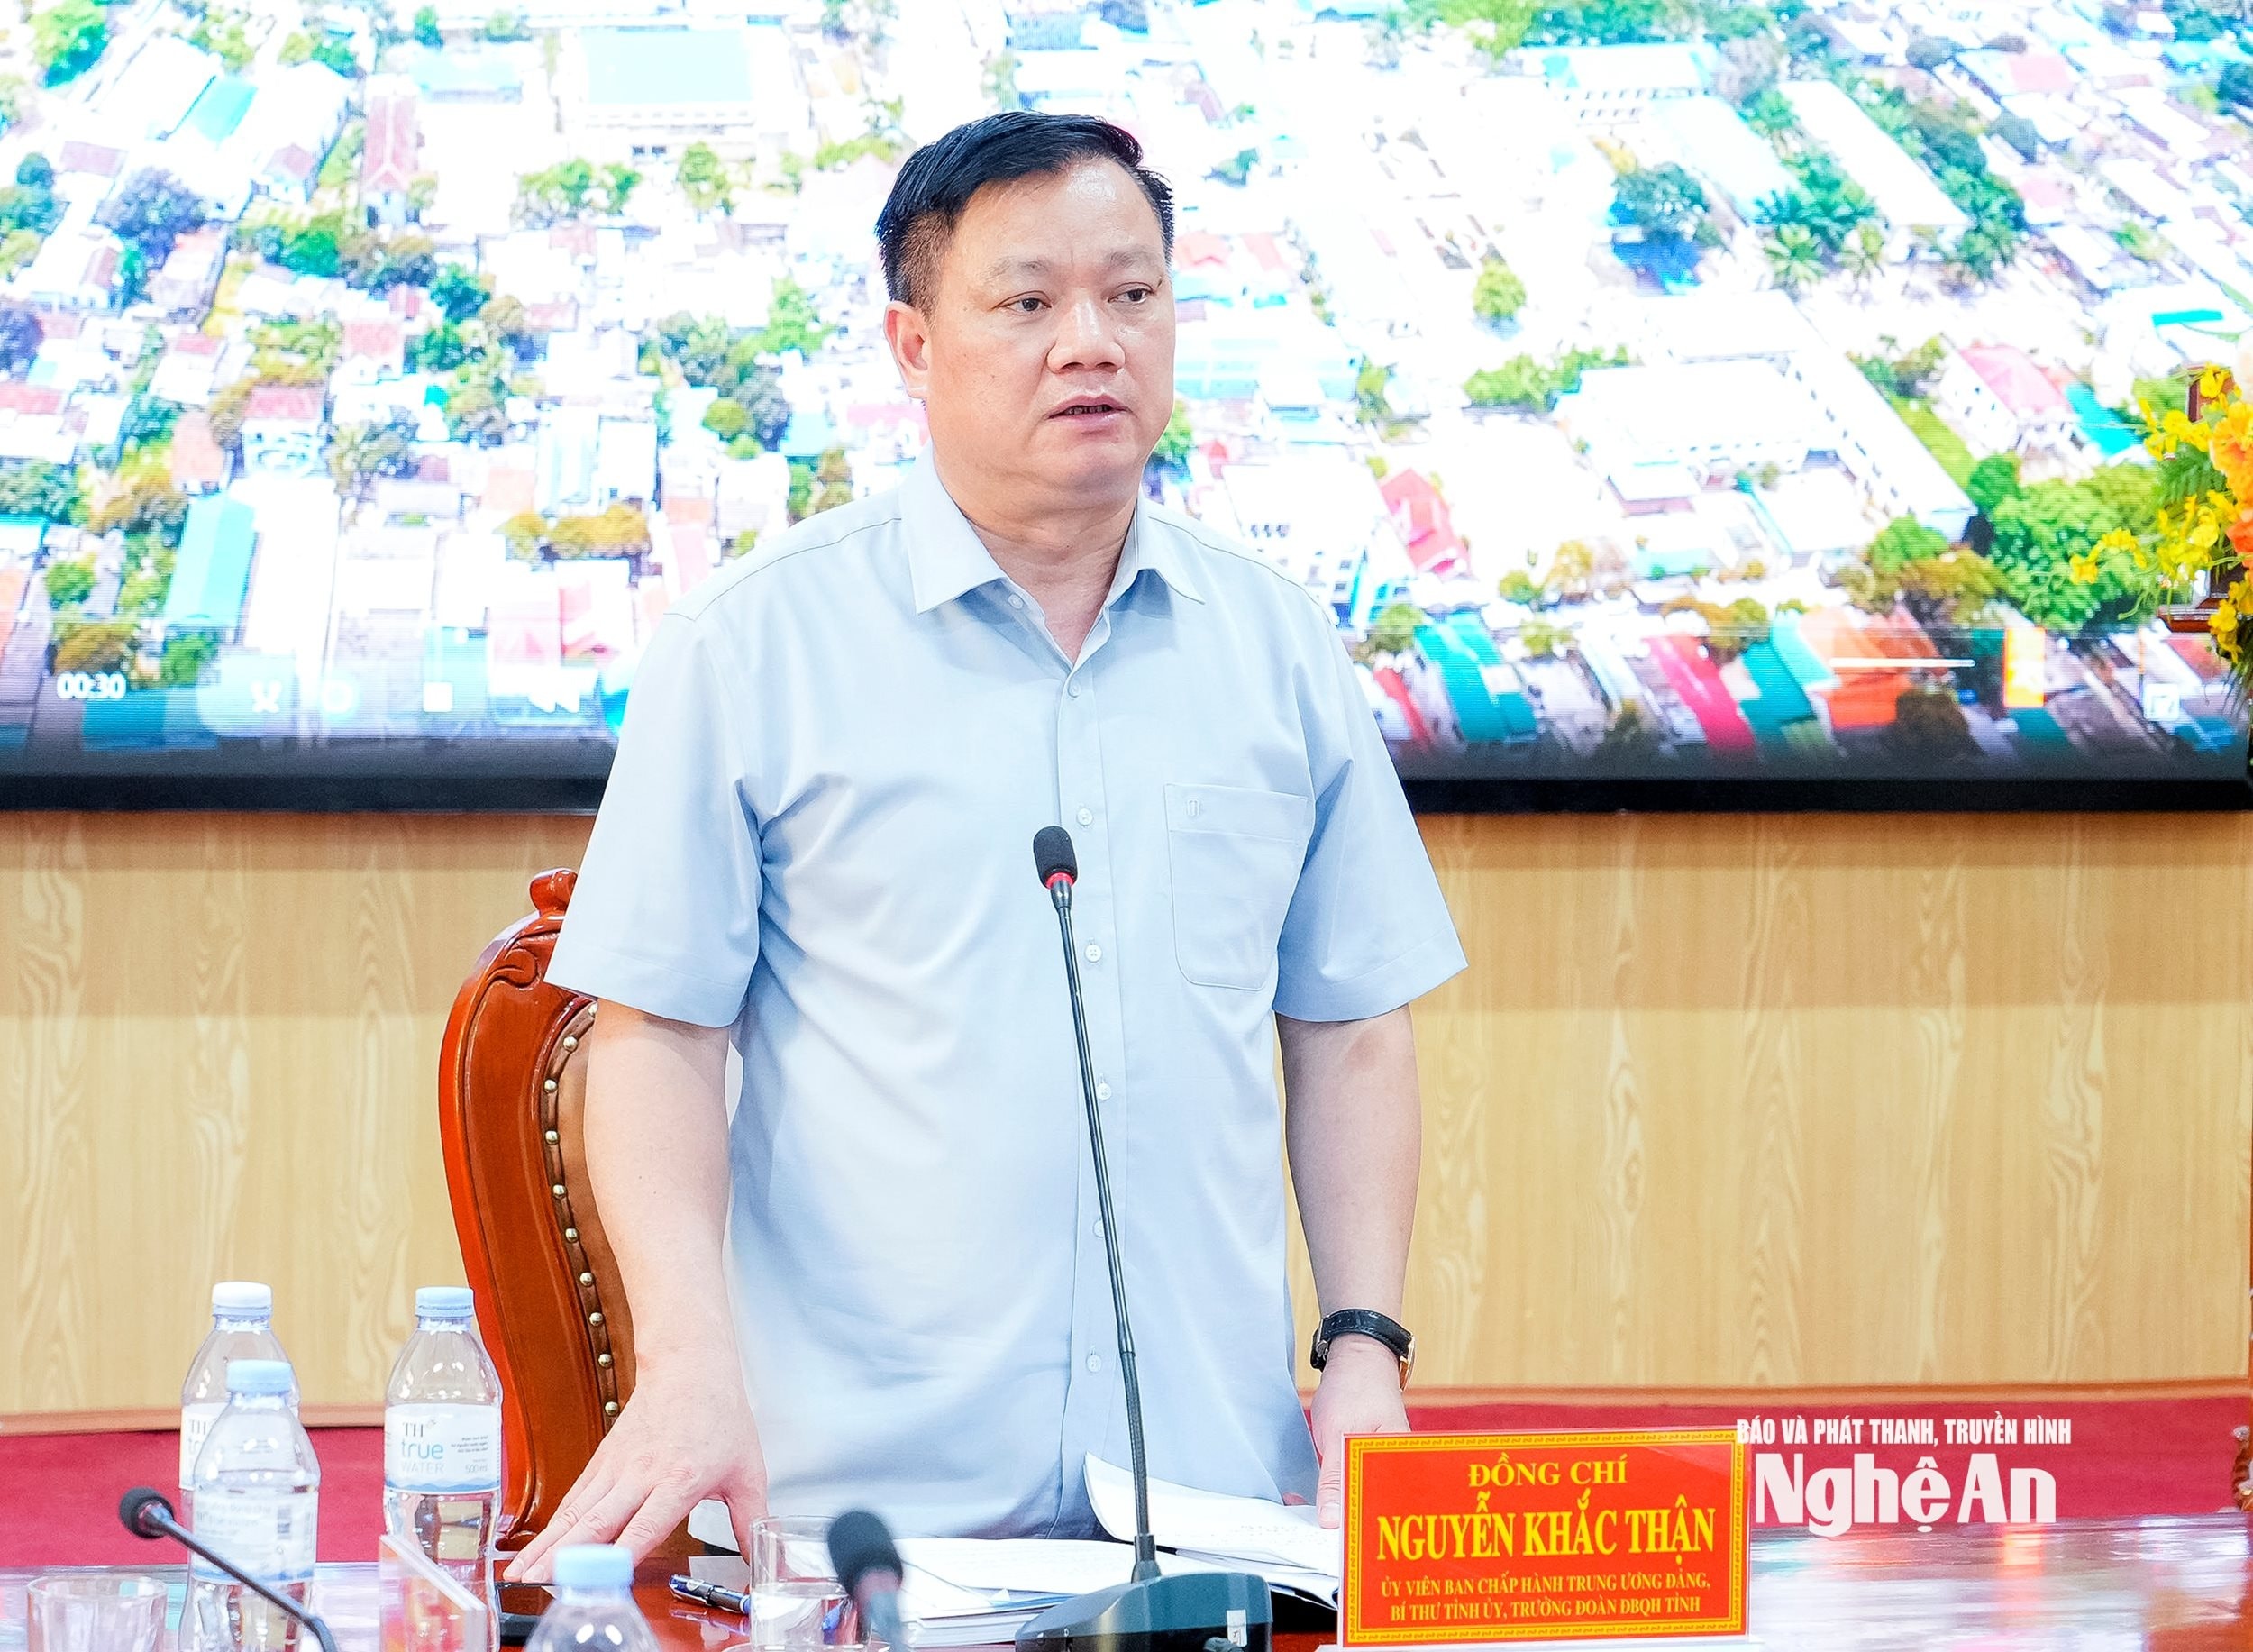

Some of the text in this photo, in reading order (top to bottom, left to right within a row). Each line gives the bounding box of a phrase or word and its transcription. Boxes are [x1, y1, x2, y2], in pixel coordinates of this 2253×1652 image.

[401, 1438, 444, 1460] true
[1467, 1451, 1628, 1488] ĐỒNG CHÍ
[1376, 1487, 1717, 1565] NGUYỄN KHẮC THẬN
[1406, 1574, 1441, 1597] VIÊN
[1445, 1578, 1474, 1595] BAN
[1477, 1570, 1519, 1594] CHẤP
[1521, 1572, 1564, 1593] HÀNH
[1566, 1574, 1617, 1593] TRUNG
[1620, 1571, 1662, 1591] ƯƠNG
[1391, 1600, 1407, 1622] BÍ
[1409, 1602, 1441, 1621] THƯ
[1510, 1595, 1572, 1619] TRƯỜNG
[1575, 1594, 1617, 1616] ĐOÀN
[1619, 1596, 1662, 1617] ĐBQH
